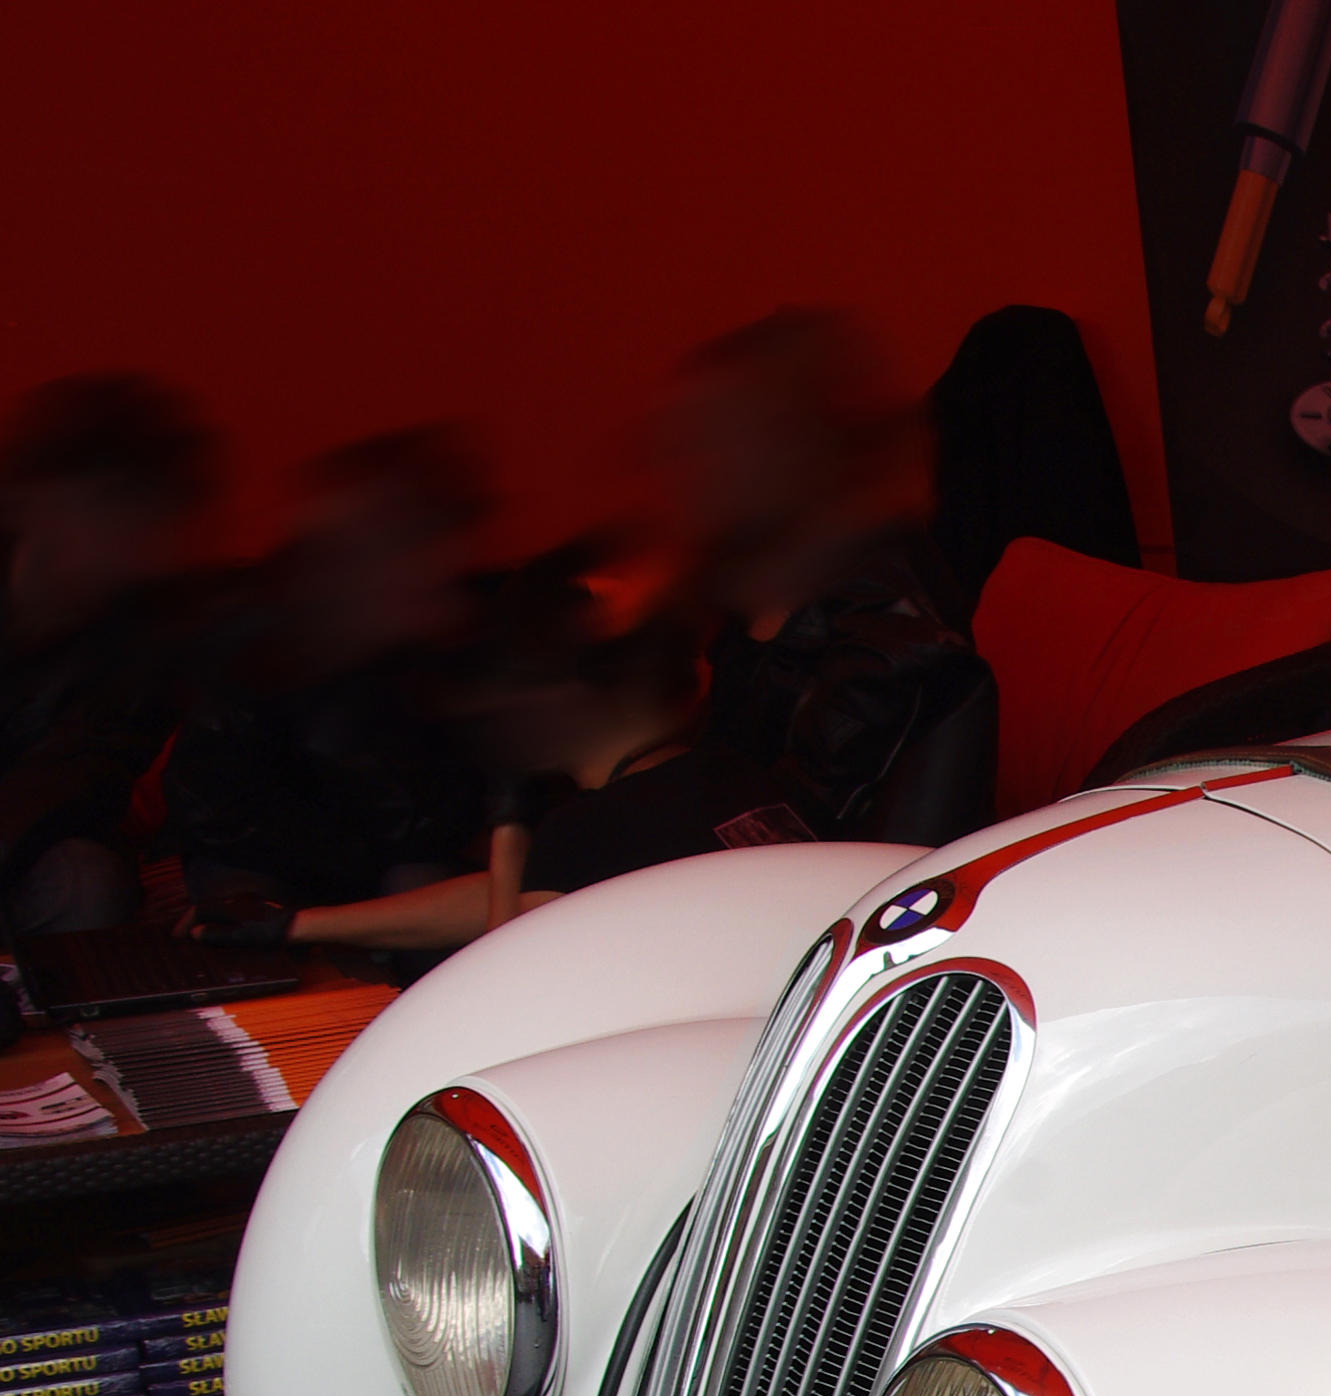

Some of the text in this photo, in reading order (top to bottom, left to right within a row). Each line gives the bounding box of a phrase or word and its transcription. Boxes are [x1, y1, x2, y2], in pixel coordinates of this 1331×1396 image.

[182, 1306, 229, 1328] SŁAW
[21, 1328, 100, 1352] SPORTU
[19, 1355, 97, 1380] SPORTU
[179, 1354, 225, 1374] SŁAW
